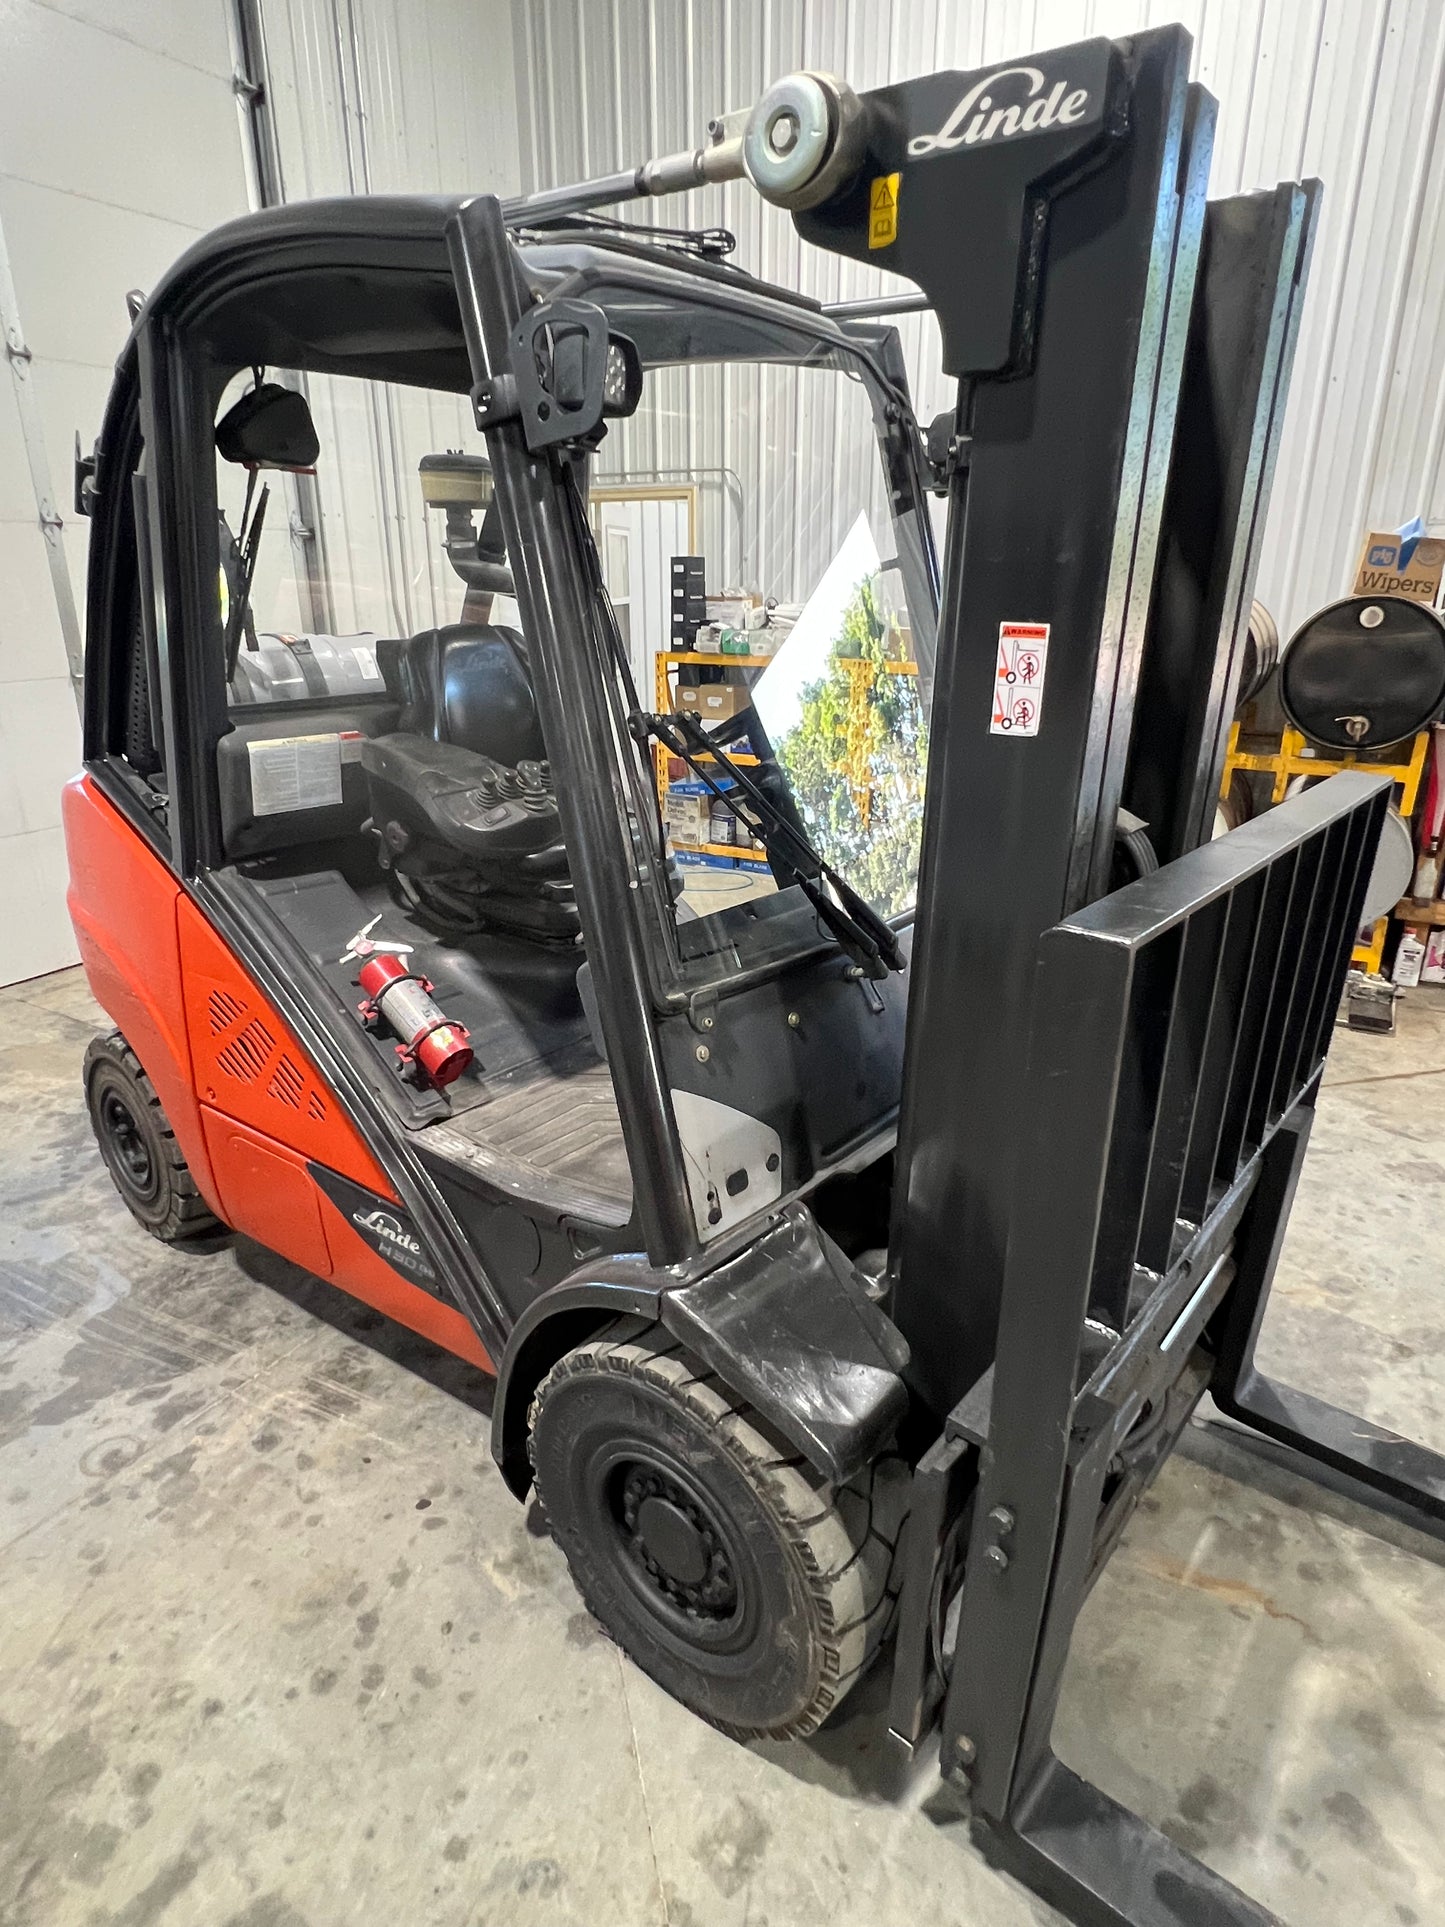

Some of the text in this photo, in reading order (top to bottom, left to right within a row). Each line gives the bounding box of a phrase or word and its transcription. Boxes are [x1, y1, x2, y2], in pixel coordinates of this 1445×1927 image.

[907, 66, 1089, 156] Linde
[1361, 570, 1435, 594] Wipers
[352, 1210, 421, 1255] Linde
